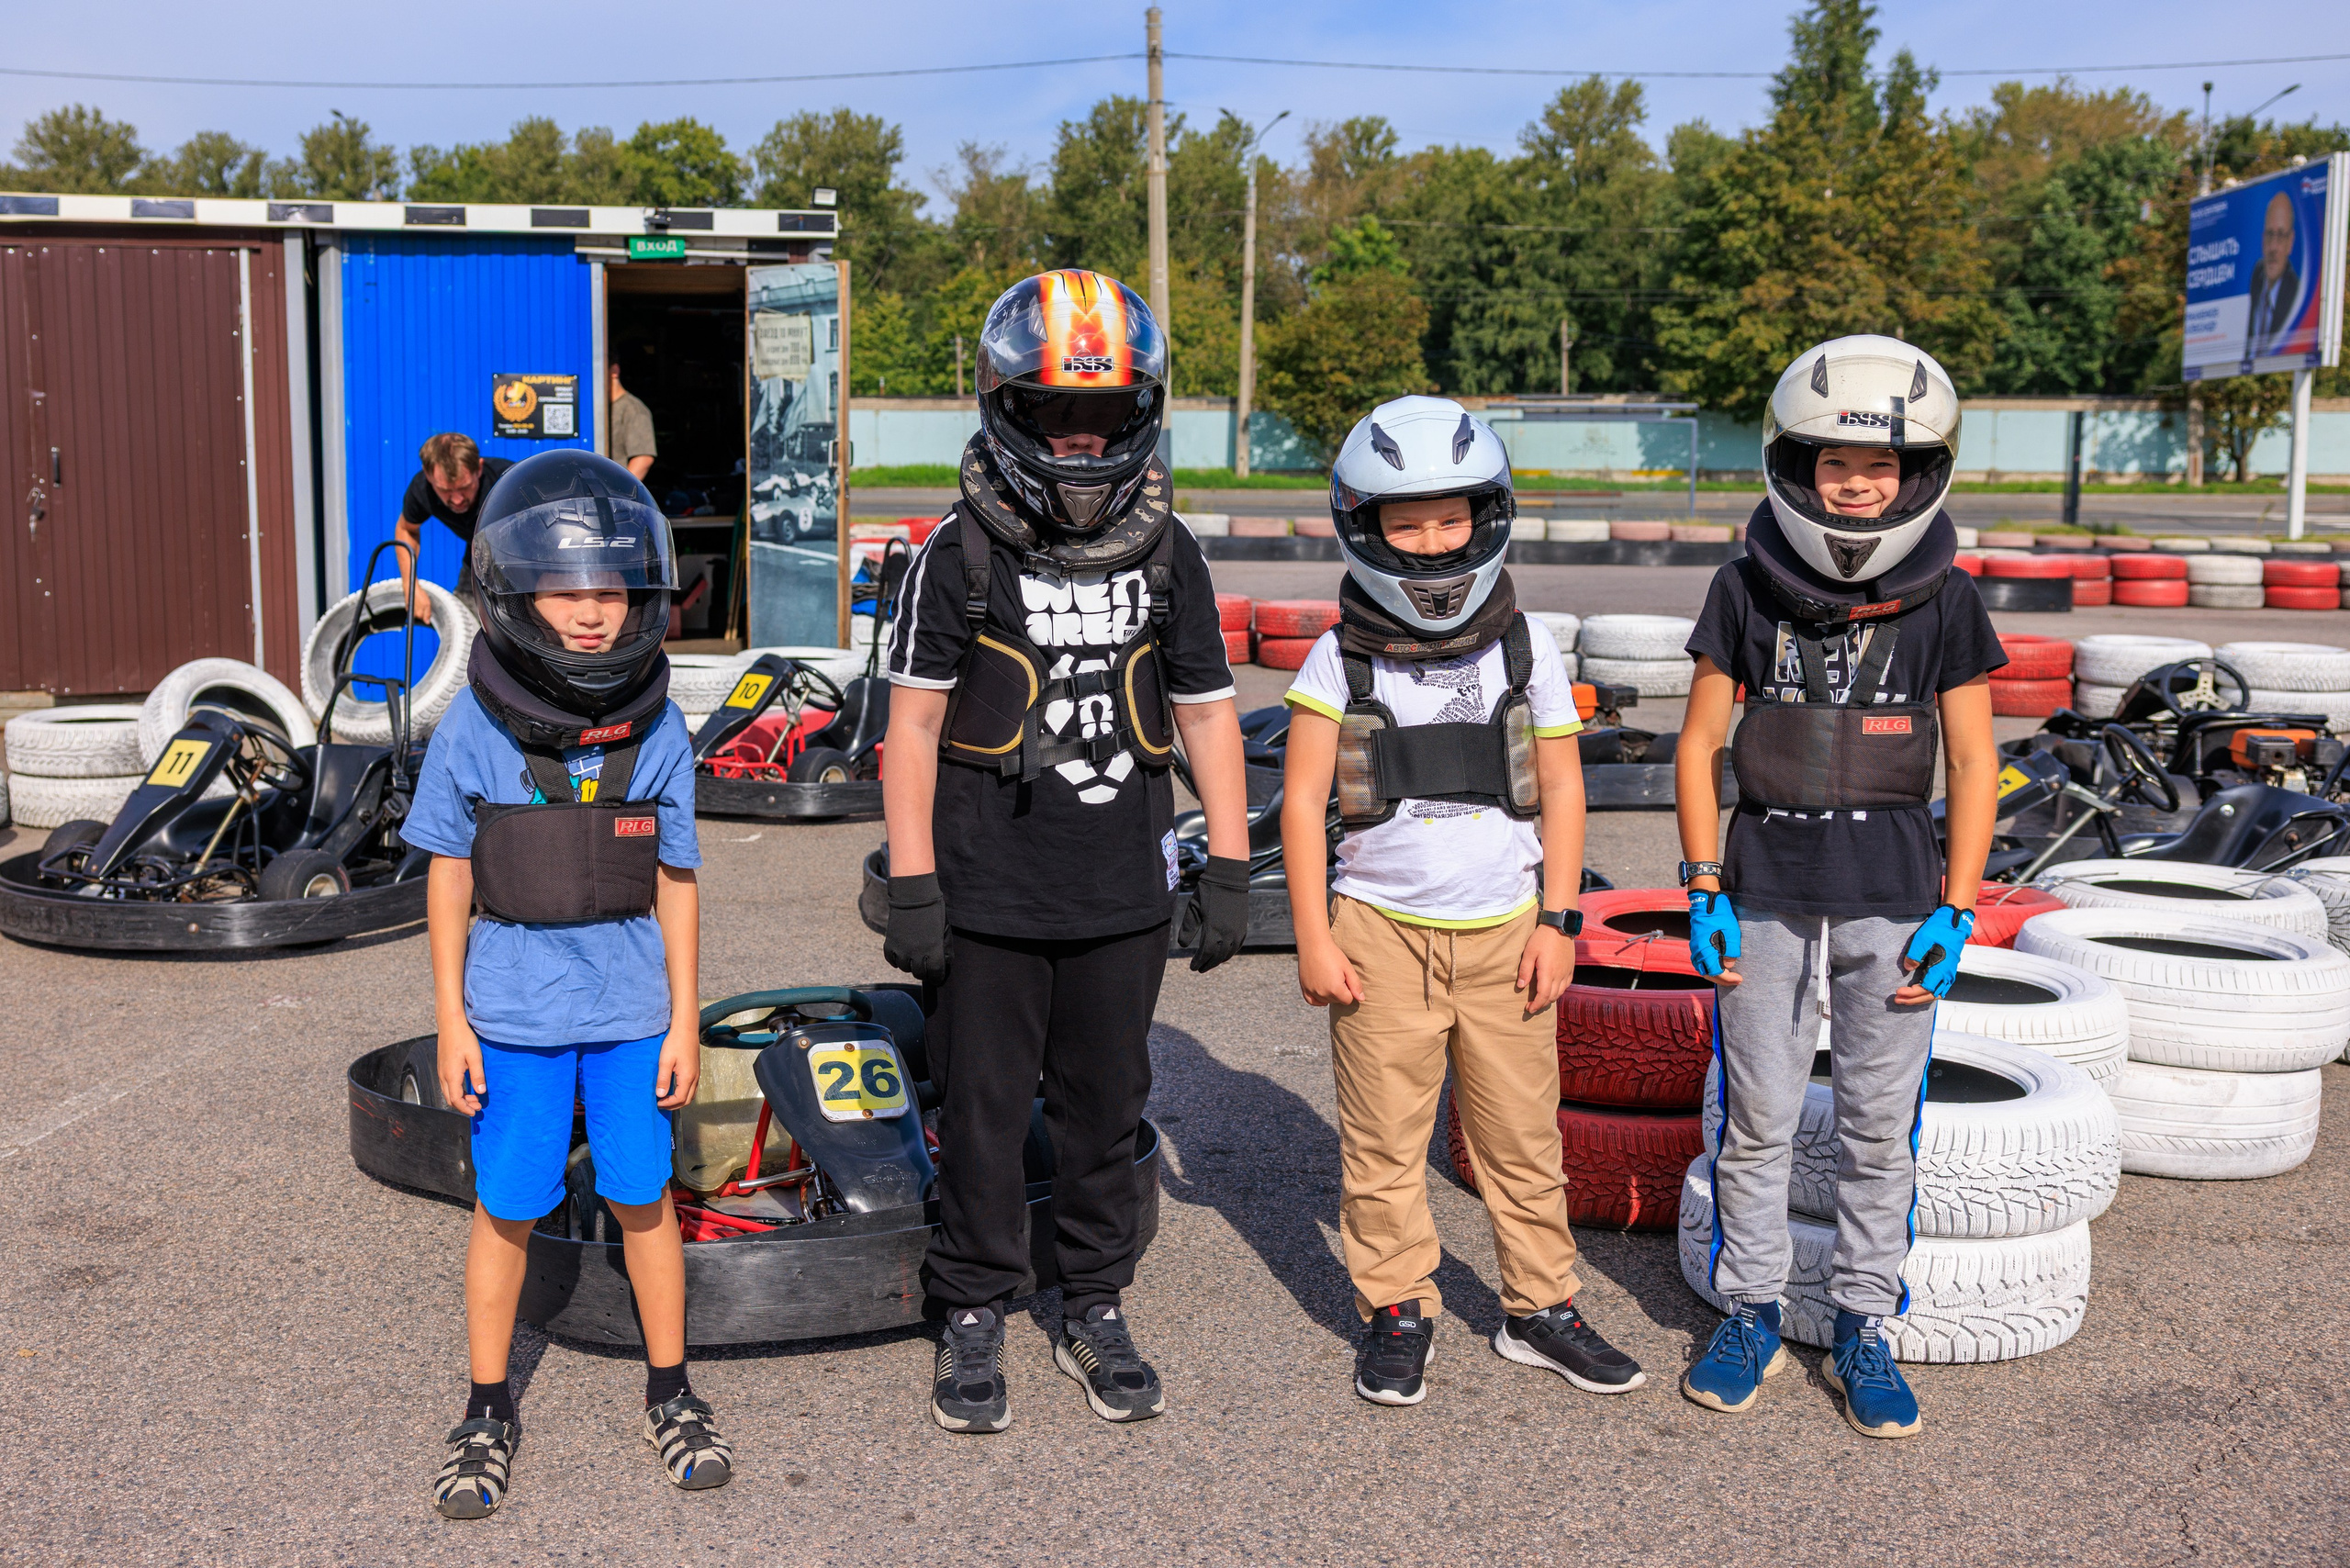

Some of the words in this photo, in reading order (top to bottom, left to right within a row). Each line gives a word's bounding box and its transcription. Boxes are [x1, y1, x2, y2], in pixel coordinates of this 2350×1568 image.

[636, 240, 677, 252] ВХОД
[522, 375, 575, 385] КАРТИНГ
[558, 536, 636, 549] LS2
[739, 682, 759, 700] 10
[1457, 683, 1480, 697] t-rex
[1868, 720, 1907, 731] RLG
[585, 725, 628, 740] RLG
[167, 752, 194, 775] 11
[620, 821, 652, 834] RLG
[818, 1058, 901, 1101] 26
